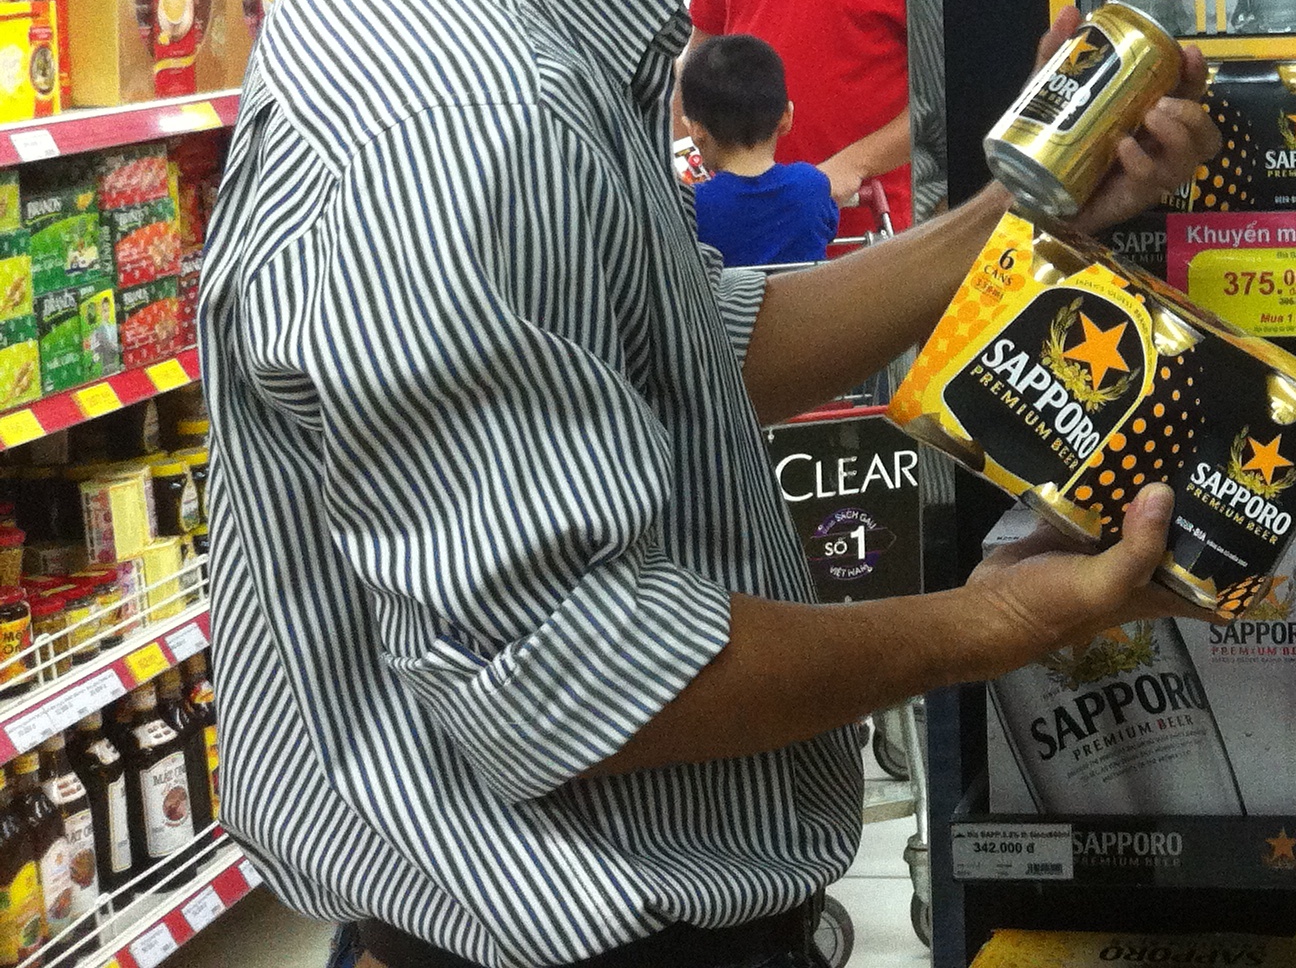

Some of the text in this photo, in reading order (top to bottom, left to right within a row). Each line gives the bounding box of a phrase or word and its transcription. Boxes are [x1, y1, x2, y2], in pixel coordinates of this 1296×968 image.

[1112, 232, 1167, 252] SAPP
[1186, 220, 1270, 248] Khuyến
[999, 248, 1018, 270] 6
[983, 264, 1014, 287] CANS
[1260, 313, 1284, 323] Mua
[1287, 313, 1293, 323] 1
[981, 338, 1101, 460] SAPPORO
[970, 365, 1080, 472] PREMIUM BEER
[775, 449, 919, 502] CLEAR
[1186, 482, 1279, 546] PREMIUM BEER
[1190, 462, 1292, 537] SAPPORO
[850, 525, 866, 560] 1
[1211, 645, 1277, 656] PREMIUM
[1031, 671, 1210, 761] SAPPORO
[1072, 721, 1154, 762] PREMIUM
[1157, 714, 1194, 731] BEER
[973, 842, 1023, 854] 342.000
[1072, 831, 1183, 855] SAPPORO
